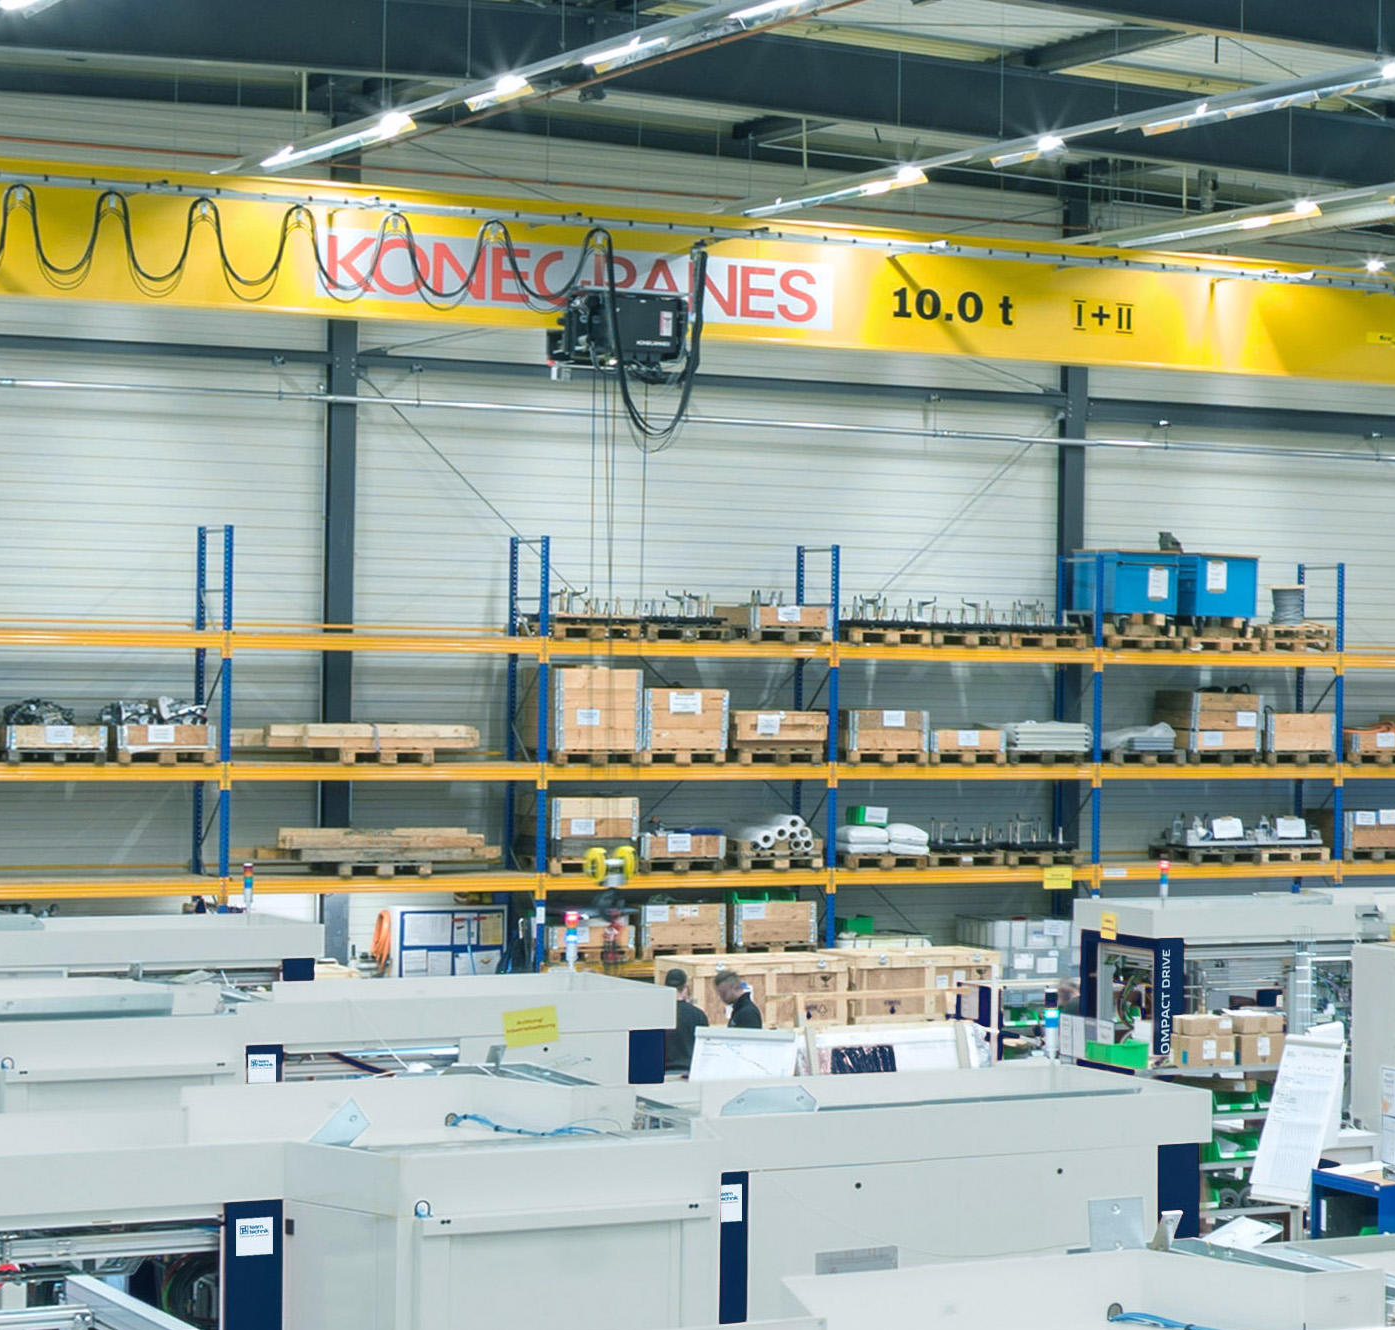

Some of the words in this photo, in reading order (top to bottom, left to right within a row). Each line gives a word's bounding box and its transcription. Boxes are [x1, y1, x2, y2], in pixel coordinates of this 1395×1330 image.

[892, 286, 984, 323] 10.0
[998, 294, 1015, 326] t
[1161, 948, 1172, 989] DRIVE
[1160, 992, 1172, 1056] OMPACT
